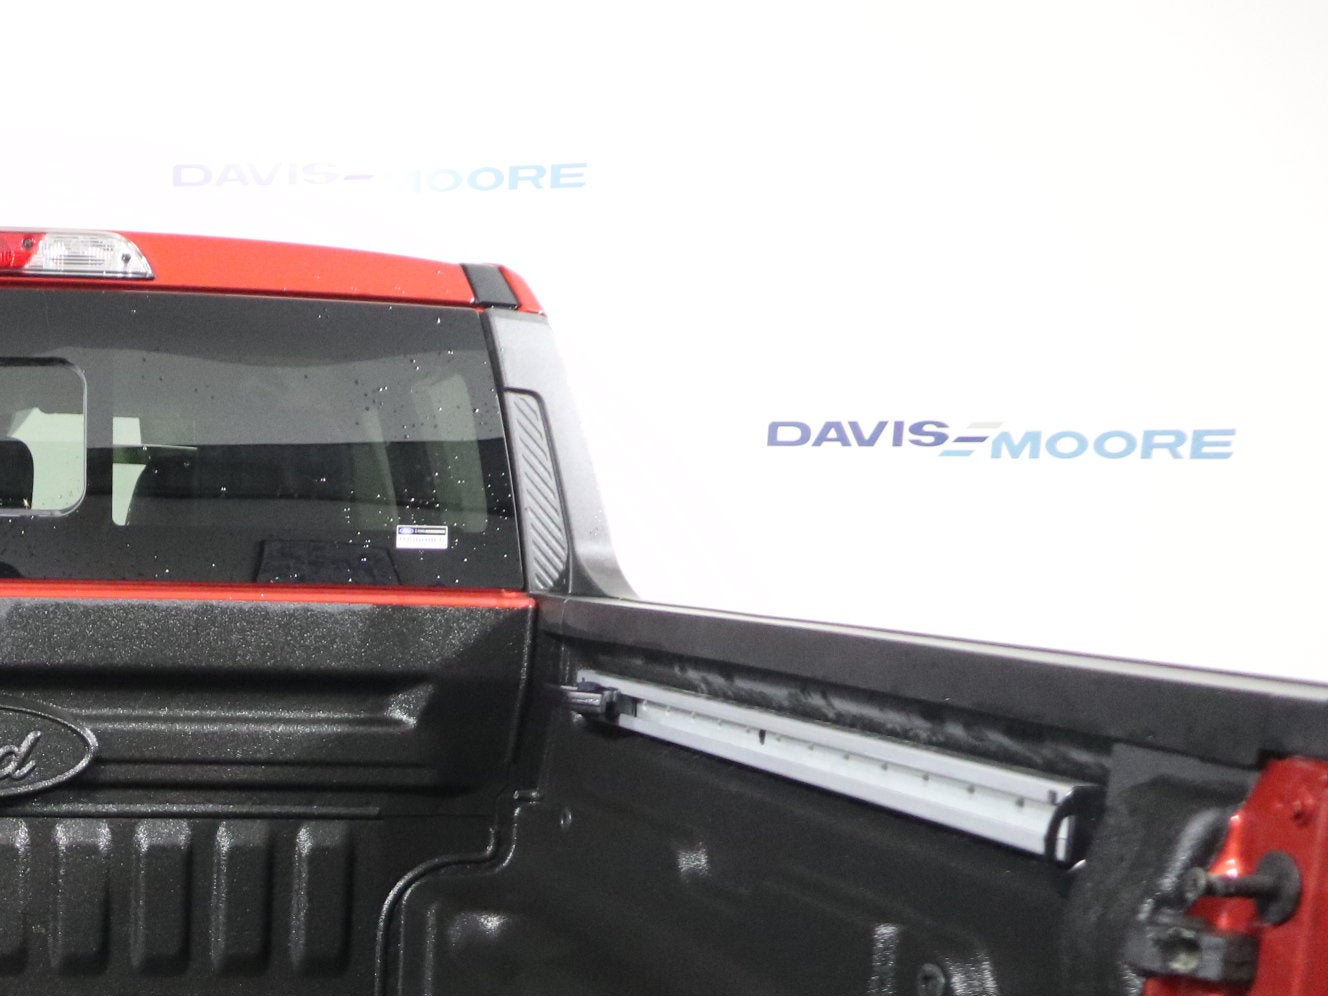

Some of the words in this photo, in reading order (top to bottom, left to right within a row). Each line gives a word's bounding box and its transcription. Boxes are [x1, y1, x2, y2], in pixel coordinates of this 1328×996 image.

[172, 162, 338, 188] DAVIS
[767, 421, 950, 447] DAVIS
[991, 429, 1236, 460] MOORE
